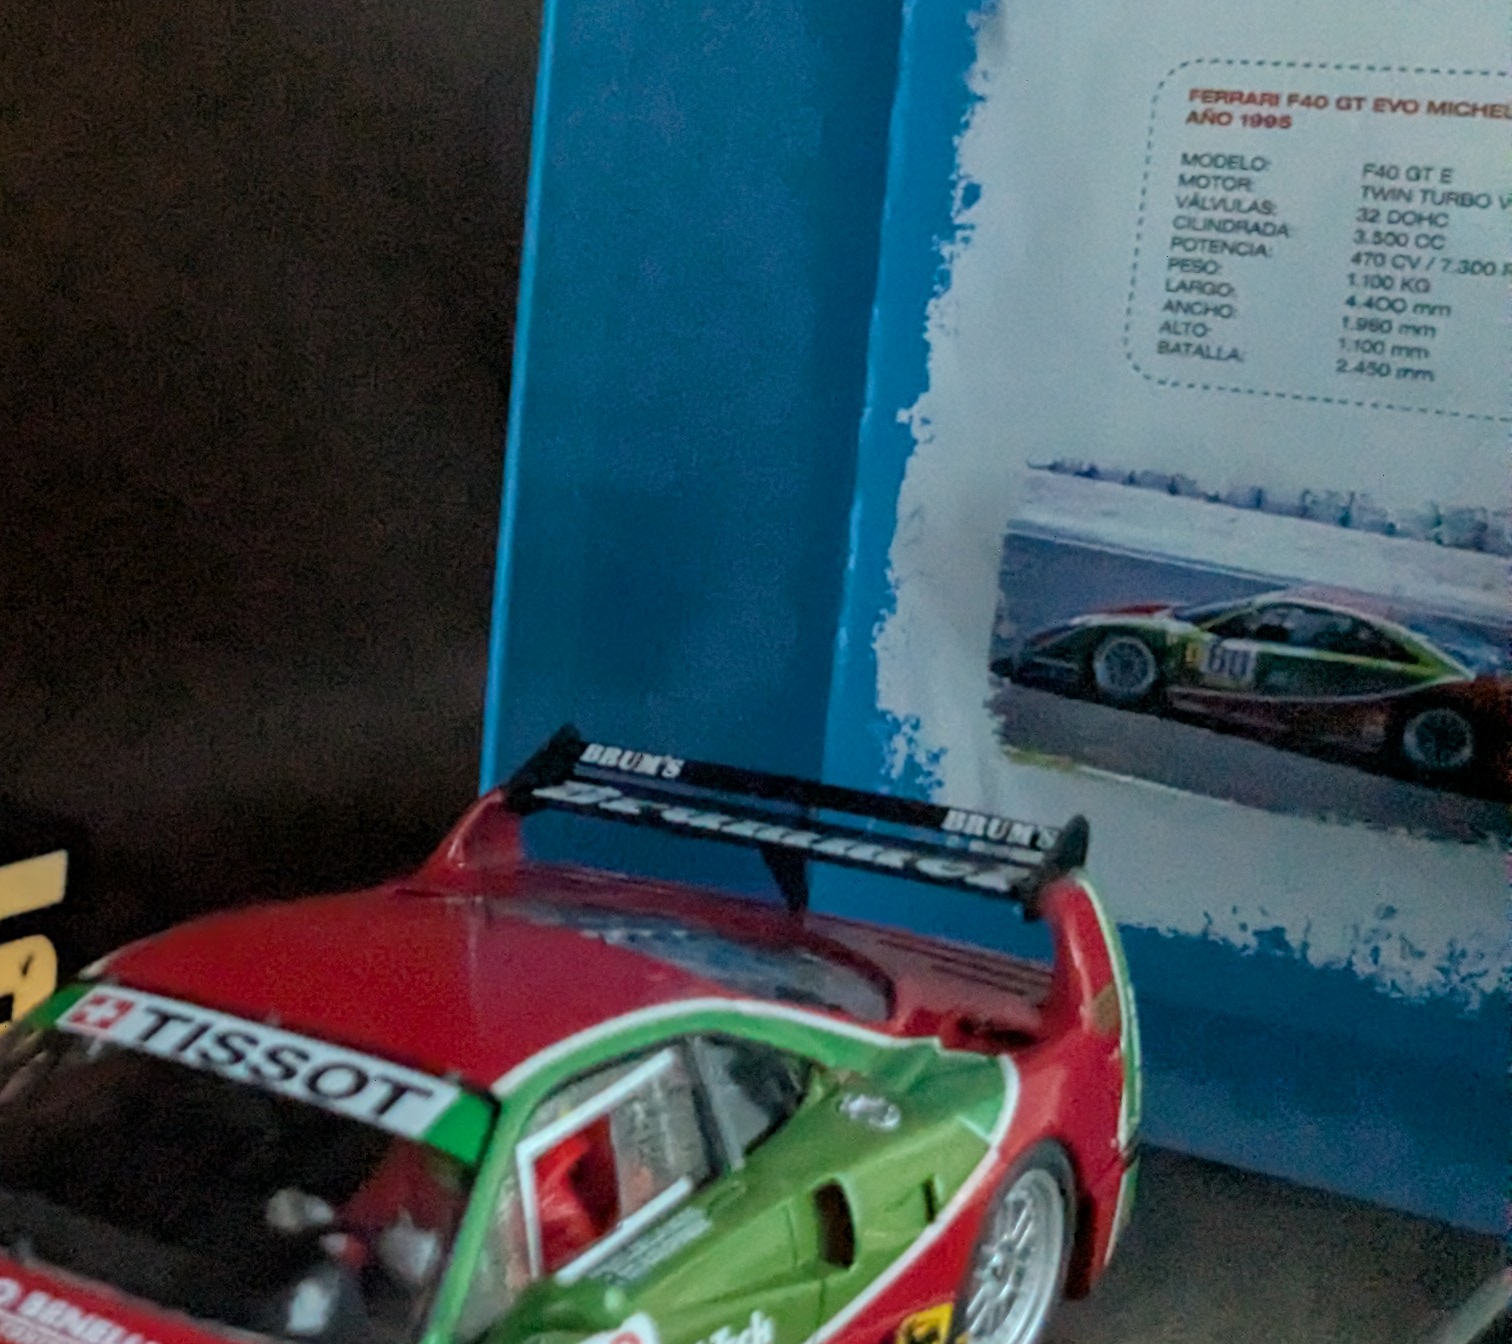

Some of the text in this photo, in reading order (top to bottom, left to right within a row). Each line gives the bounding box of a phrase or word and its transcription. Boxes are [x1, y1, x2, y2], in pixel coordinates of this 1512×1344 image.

[1188, 88, 1280, 108] FERRARI
[1287, 92, 1329, 110] F40
[1335, 96, 1368, 112] GT
[1371, 98, 1420, 115] EVO
[1186, 109, 1233, 127] AÑO
[1362, 163, 1400, 180] F40
[1406, 165, 1435, 182] GT
[1360, 185, 1412, 203] TWIN
[1420, 189, 1491, 209] TURBO
[1356, 207, 1449, 228] 32 DOHC
[1414, 233, 1446, 251] CC
[1391, 254, 1422, 270] CV
[1412, 302, 1452, 317] mm
[1398, 323, 1437, 338] mm
[1390, 344, 1430, 359] mm
[1395, 366, 1435, 382] mm
[136, 1004, 434, 1118] TISSOT
